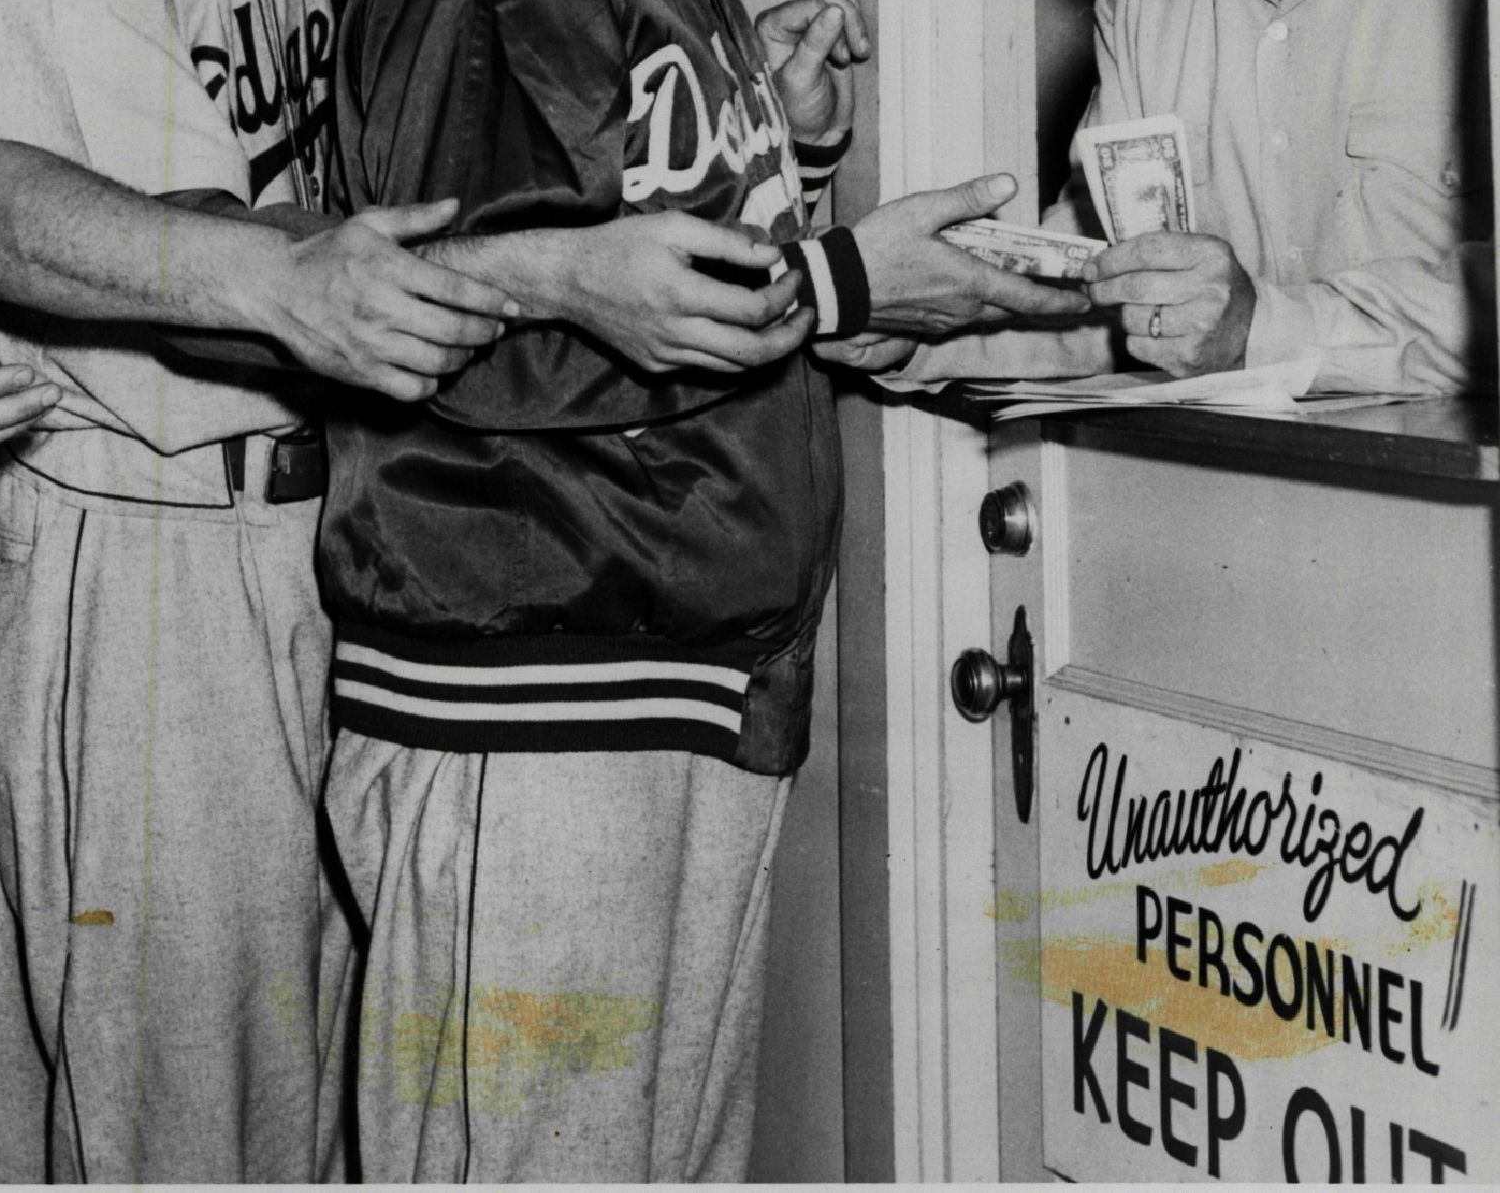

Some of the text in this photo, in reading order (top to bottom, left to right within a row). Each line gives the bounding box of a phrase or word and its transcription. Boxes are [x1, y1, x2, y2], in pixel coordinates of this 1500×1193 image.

[1077, 742, 1424, 923] Unauthorized
[1136, 884, 1440, 1077] PERSONNEL
[1071, 990, 1246, 1180] KEEP
